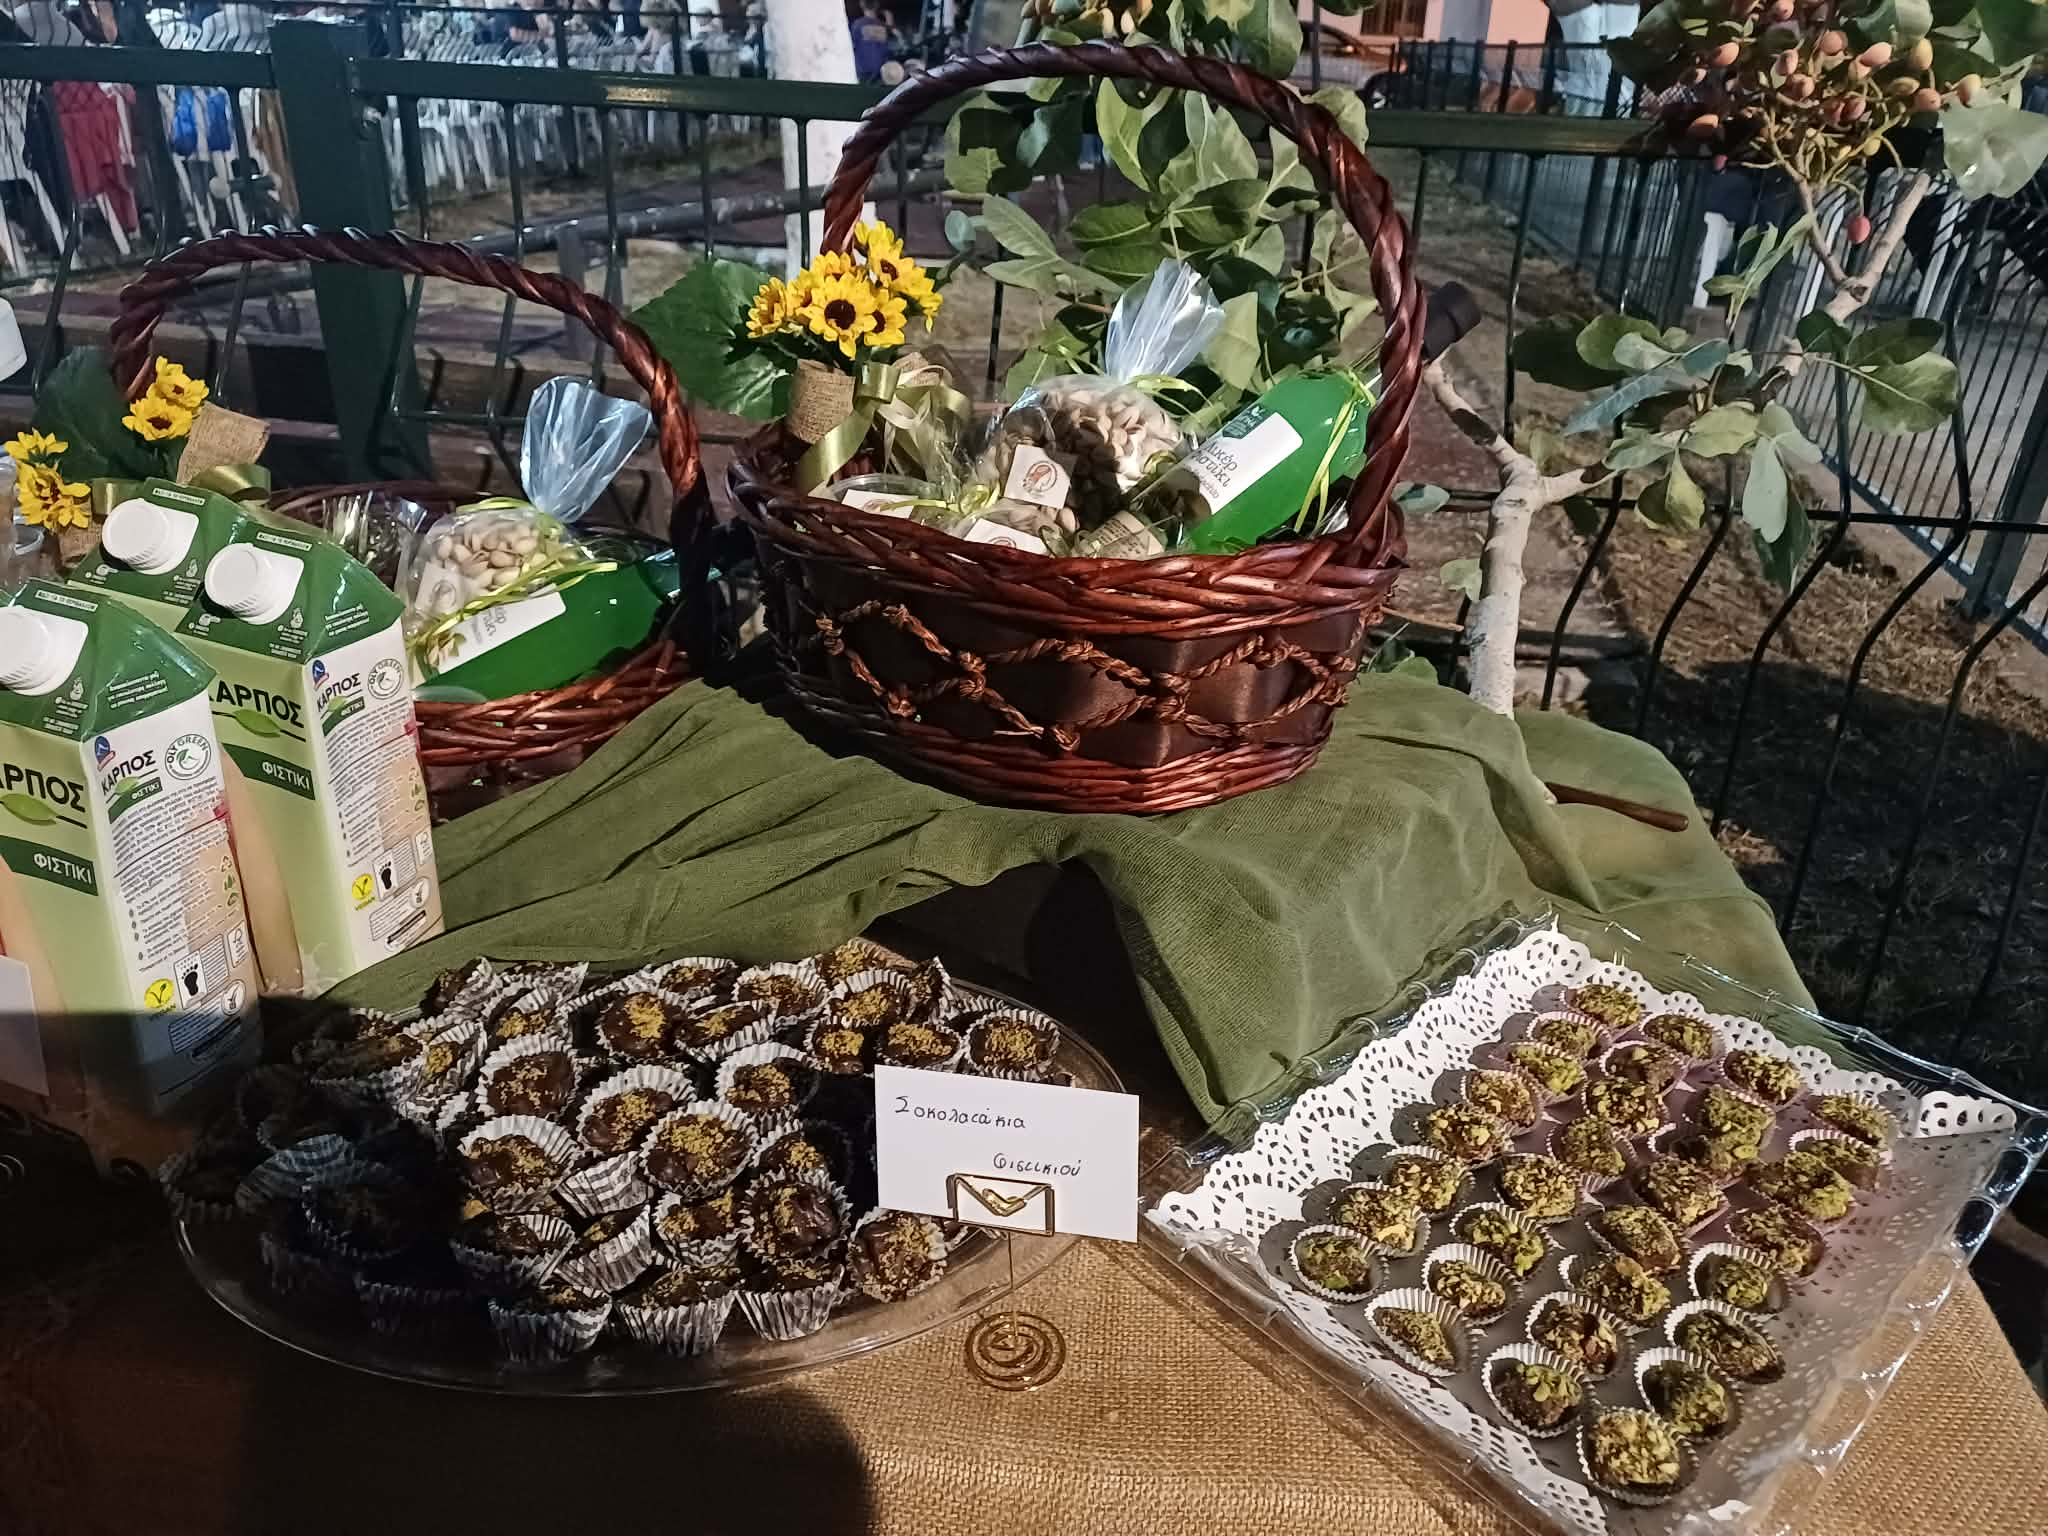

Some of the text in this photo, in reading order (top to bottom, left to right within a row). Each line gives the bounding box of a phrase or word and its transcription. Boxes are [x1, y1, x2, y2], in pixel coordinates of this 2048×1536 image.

[209, 680, 304, 728] ΑΡΠΟΣ
[317, 673, 361, 712] ΚΑΡΠΟΣ
[0, 763, 86, 813] ΡΠΟΣ
[101, 750, 157, 796] ΚΑΡΠΟΣ
[262, 760, 311, 791] ΦΙΣΤΙΚΙ
[33, 852, 92, 885] ΦΙΣΤΙΚΙ
